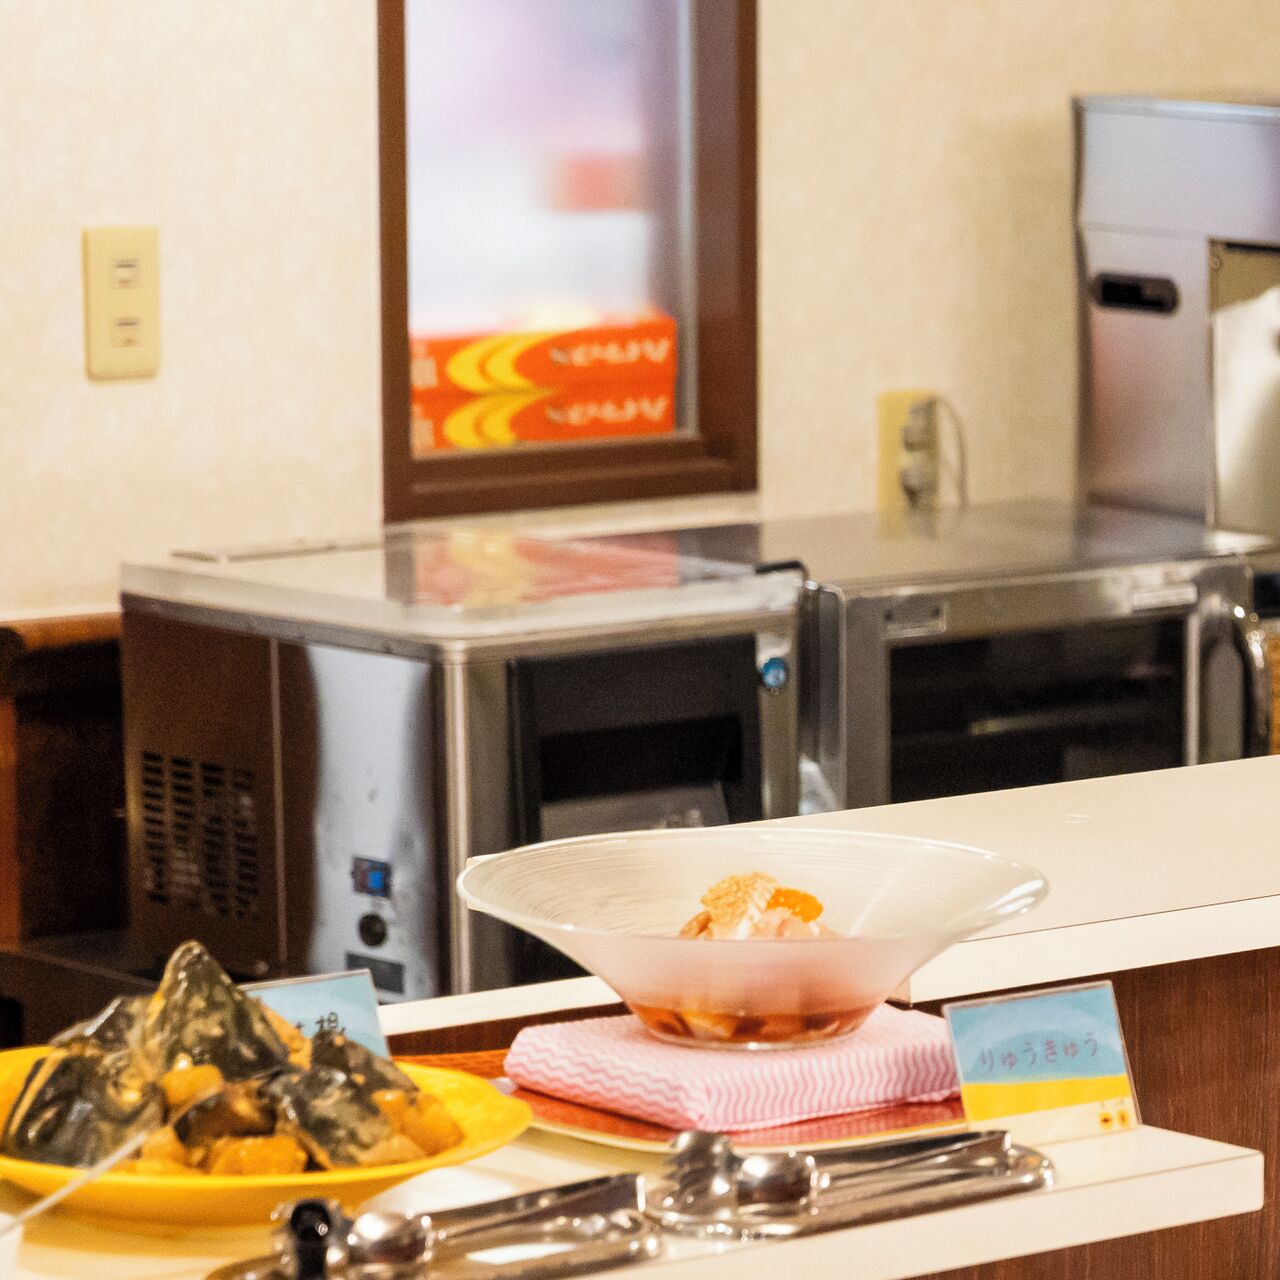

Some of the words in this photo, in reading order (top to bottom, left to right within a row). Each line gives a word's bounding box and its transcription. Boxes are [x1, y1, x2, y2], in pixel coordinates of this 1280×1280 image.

[980, 1032, 1098, 1072] りゅうきゅう
